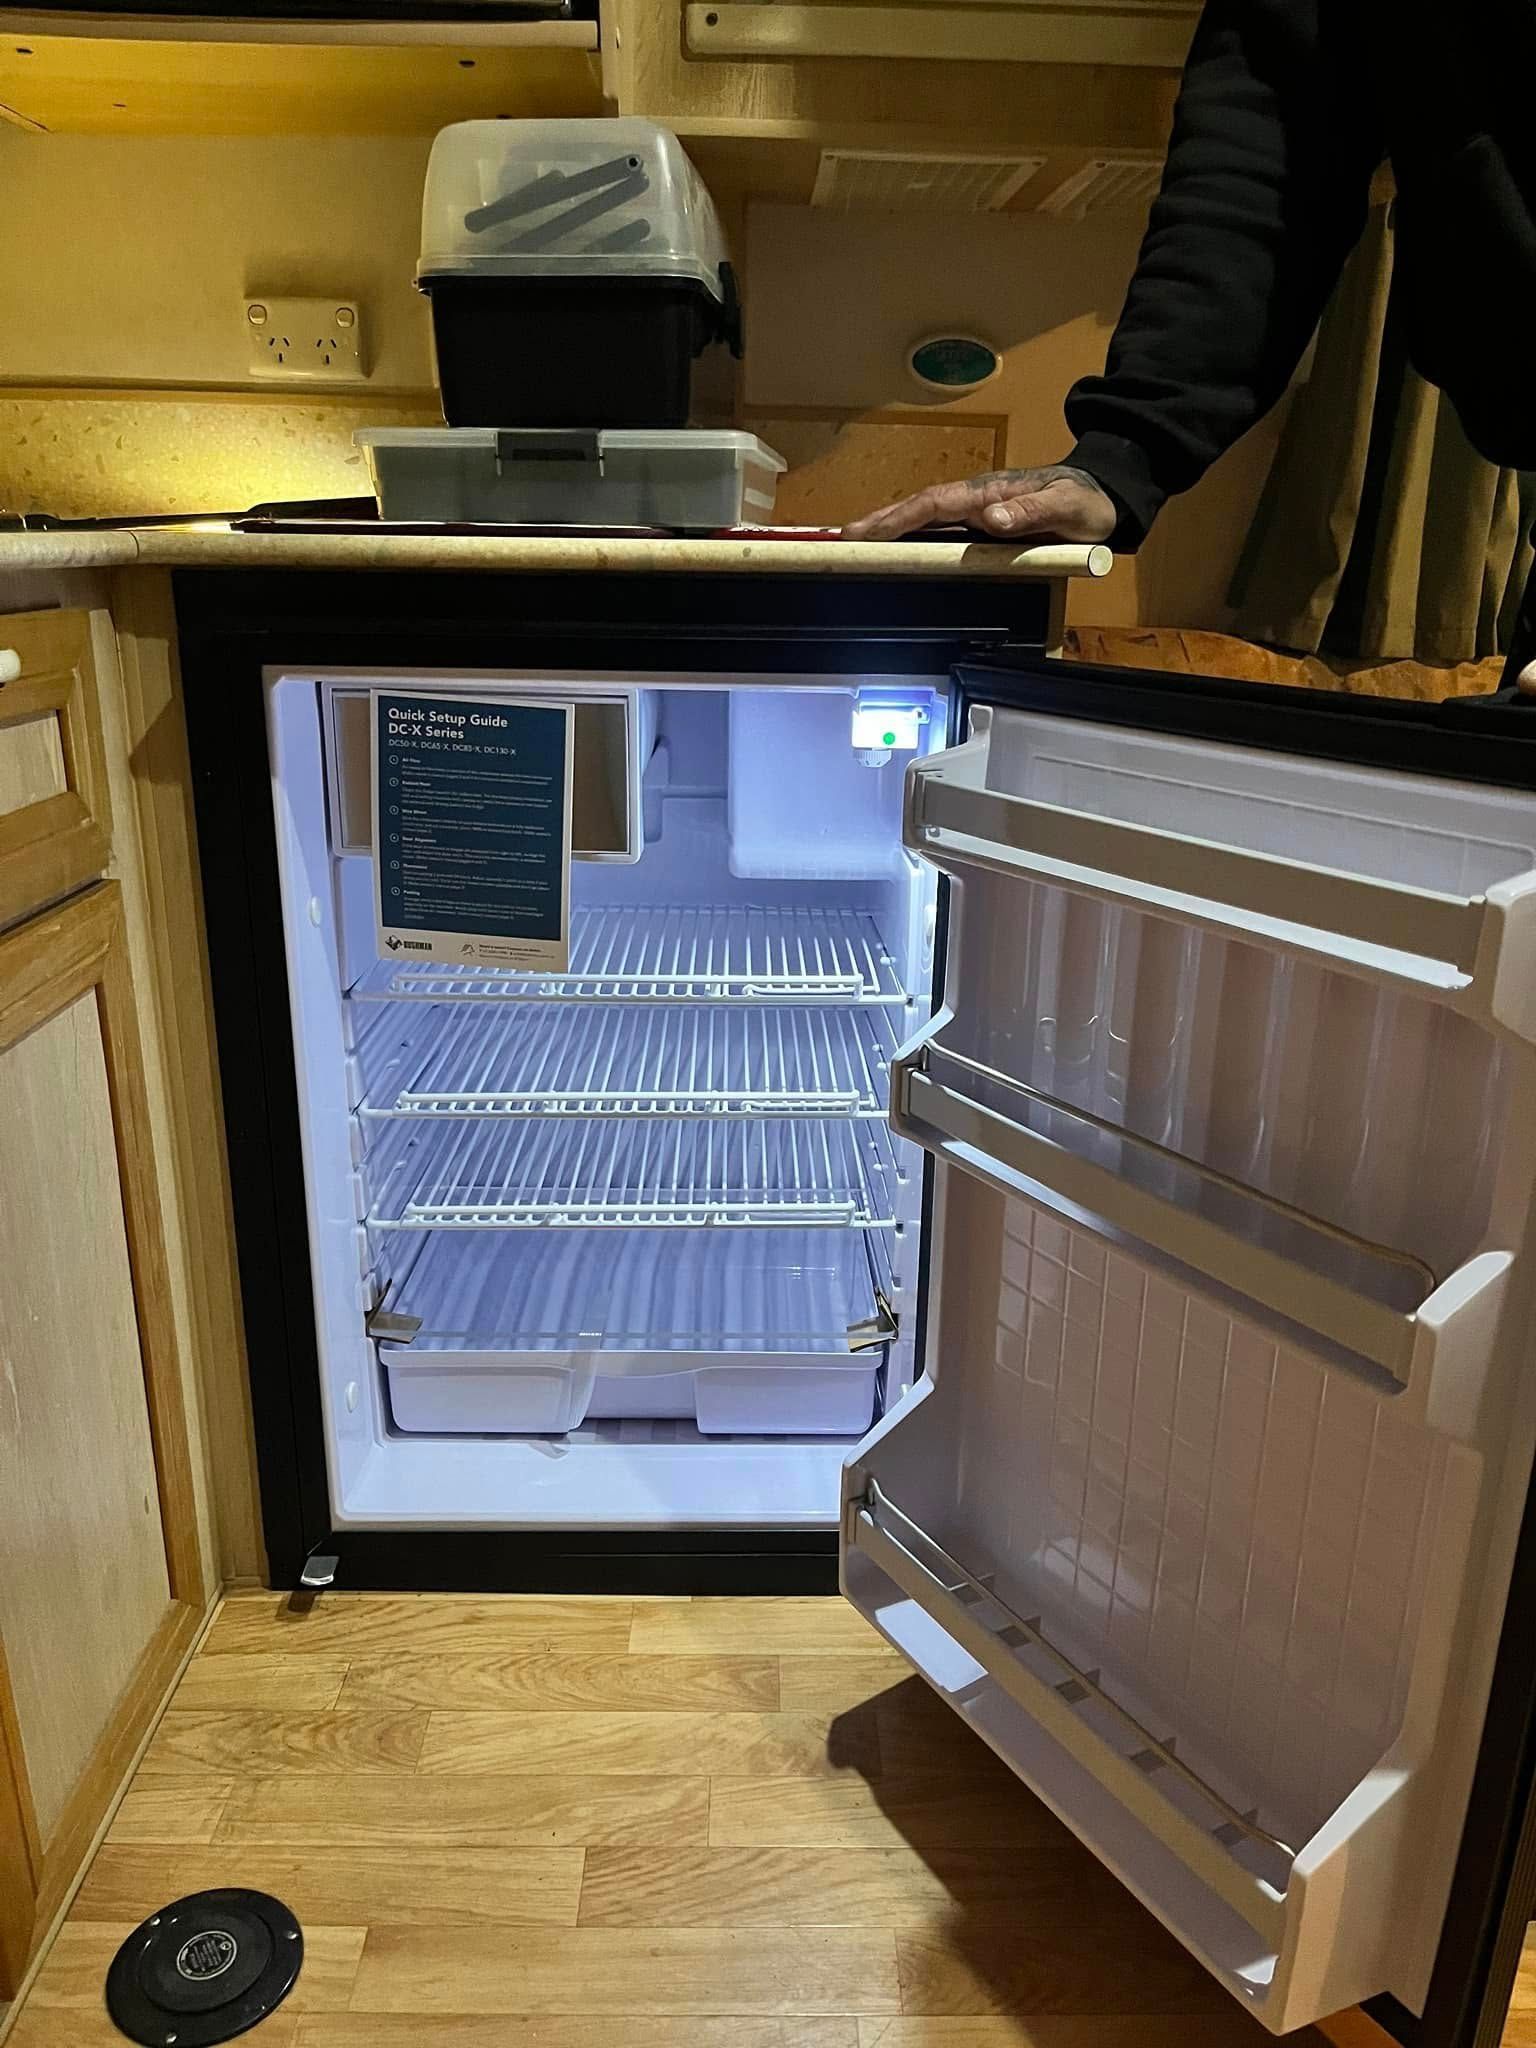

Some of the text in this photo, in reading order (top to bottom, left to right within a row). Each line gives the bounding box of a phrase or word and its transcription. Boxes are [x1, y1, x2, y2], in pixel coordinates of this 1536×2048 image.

[388, 707, 508, 728] Quick Setup Guide
[388, 722, 464, 739] DC-X Series
